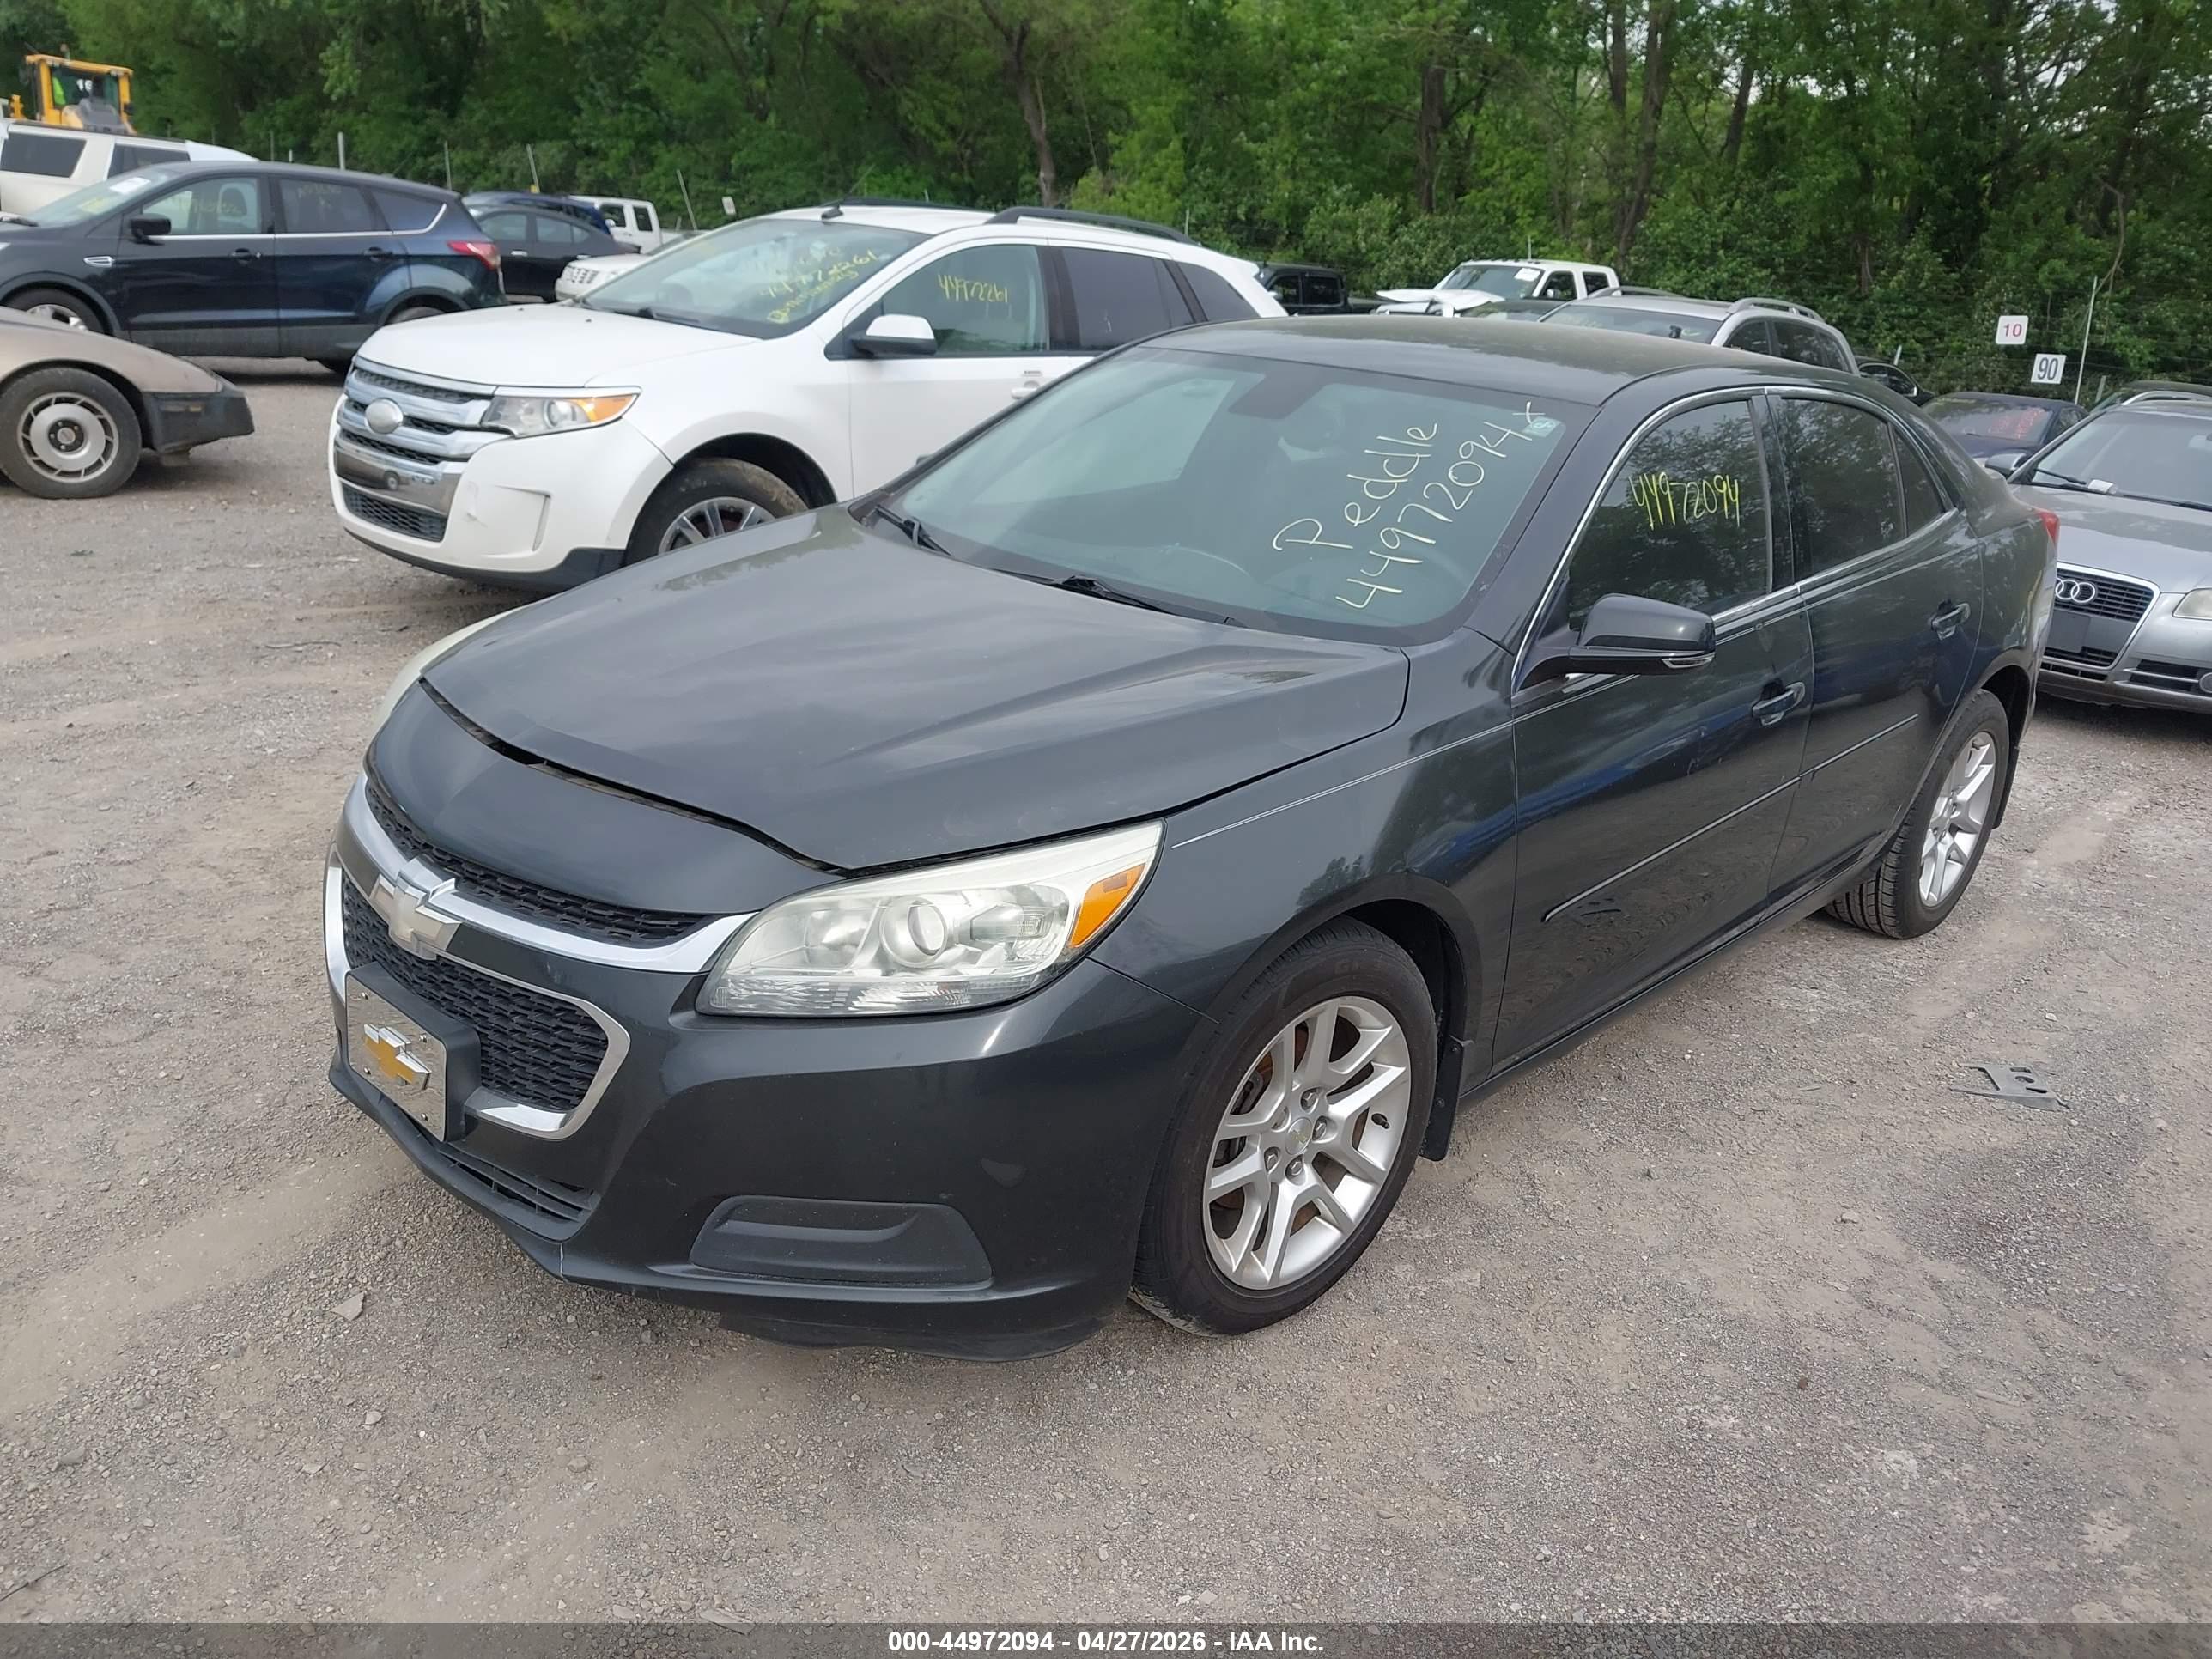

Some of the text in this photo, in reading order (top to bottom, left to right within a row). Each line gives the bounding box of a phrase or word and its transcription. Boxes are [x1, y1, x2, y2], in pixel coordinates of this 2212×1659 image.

[2003, 323, 2022, 337] 10
[2037, 356, 2058, 380] 90
[1273, 423, 1437, 550] Peddle
[1628, 471, 1740, 531] 44972094
